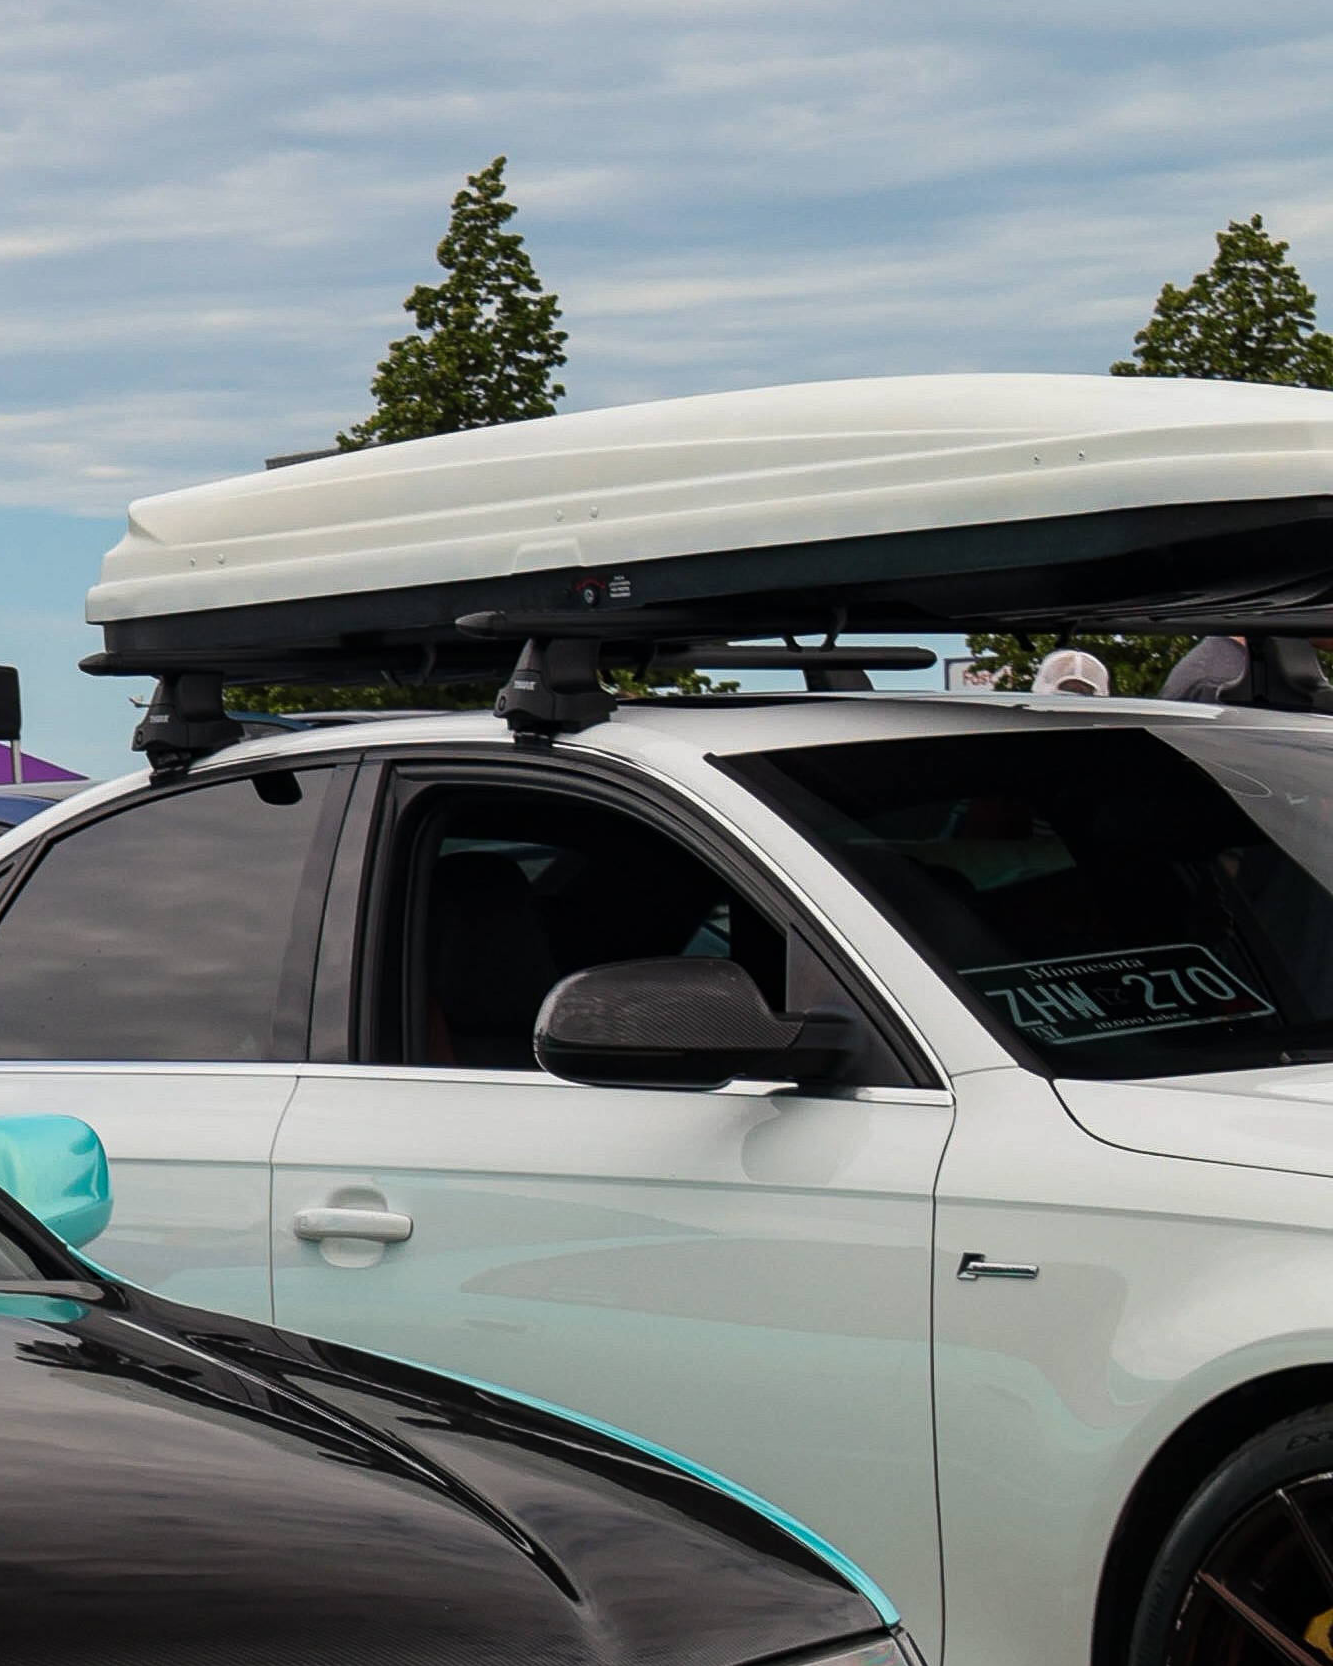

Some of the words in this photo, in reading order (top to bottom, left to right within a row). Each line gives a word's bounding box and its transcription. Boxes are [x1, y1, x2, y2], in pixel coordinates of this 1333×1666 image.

[1025, 957, 1146, 981] Minnesota
[985, 980, 1108, 1028] ZHW
[1121, 966, 1237, 1011] 270
